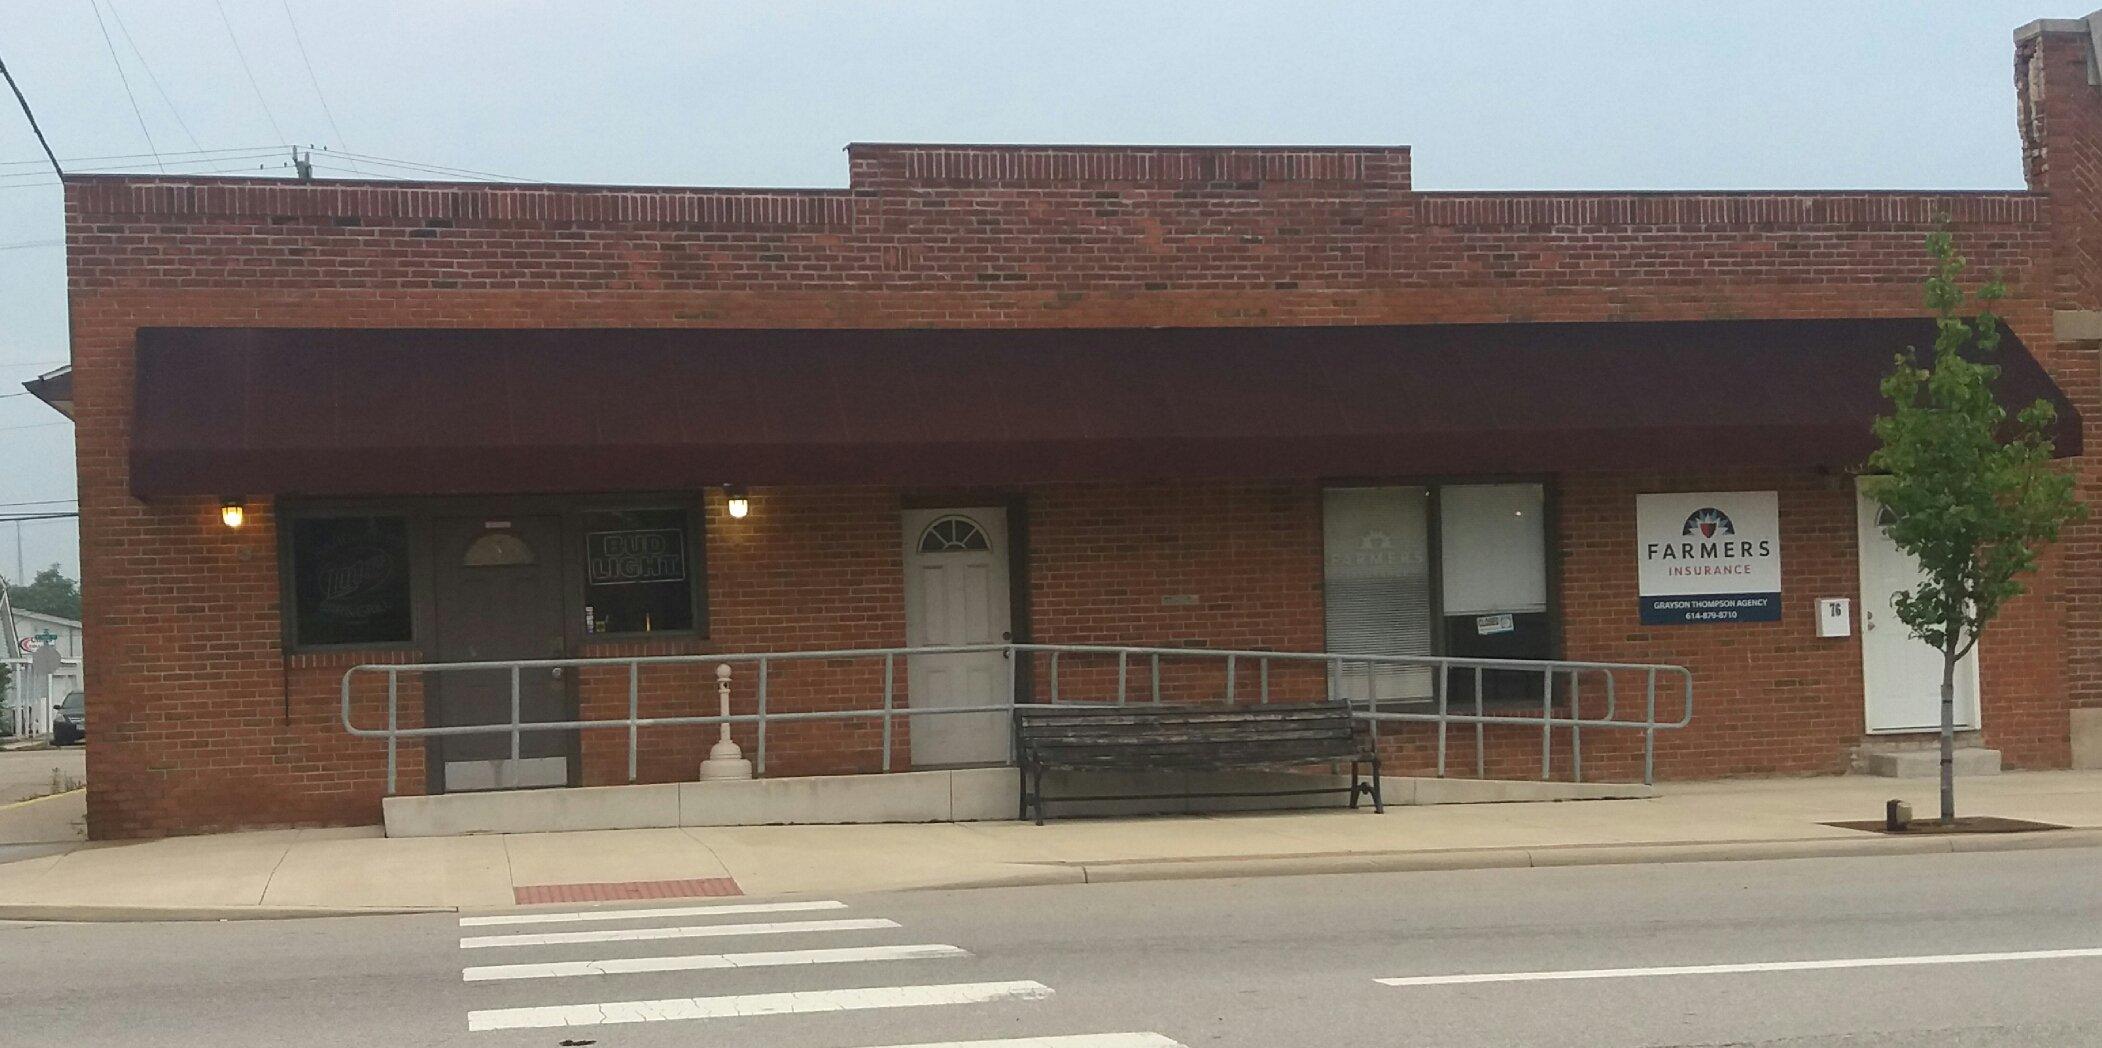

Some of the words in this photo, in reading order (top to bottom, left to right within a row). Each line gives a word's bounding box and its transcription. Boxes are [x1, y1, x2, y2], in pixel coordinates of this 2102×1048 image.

[604, 534, 666, 557] BUD
[1647, 541, 1770, 560] FARMERS
[592, 555, 680, 579] LIGHT
[1668, 564, 1751, 576] INSURANCE
[1653, 601, 1690, 609] GRAYSON
[1691, 600, 1735, 608] THOMPSON
[1736, 598, 1768, 607] AGENCY
[1829, 603, 1841, 617] 76
